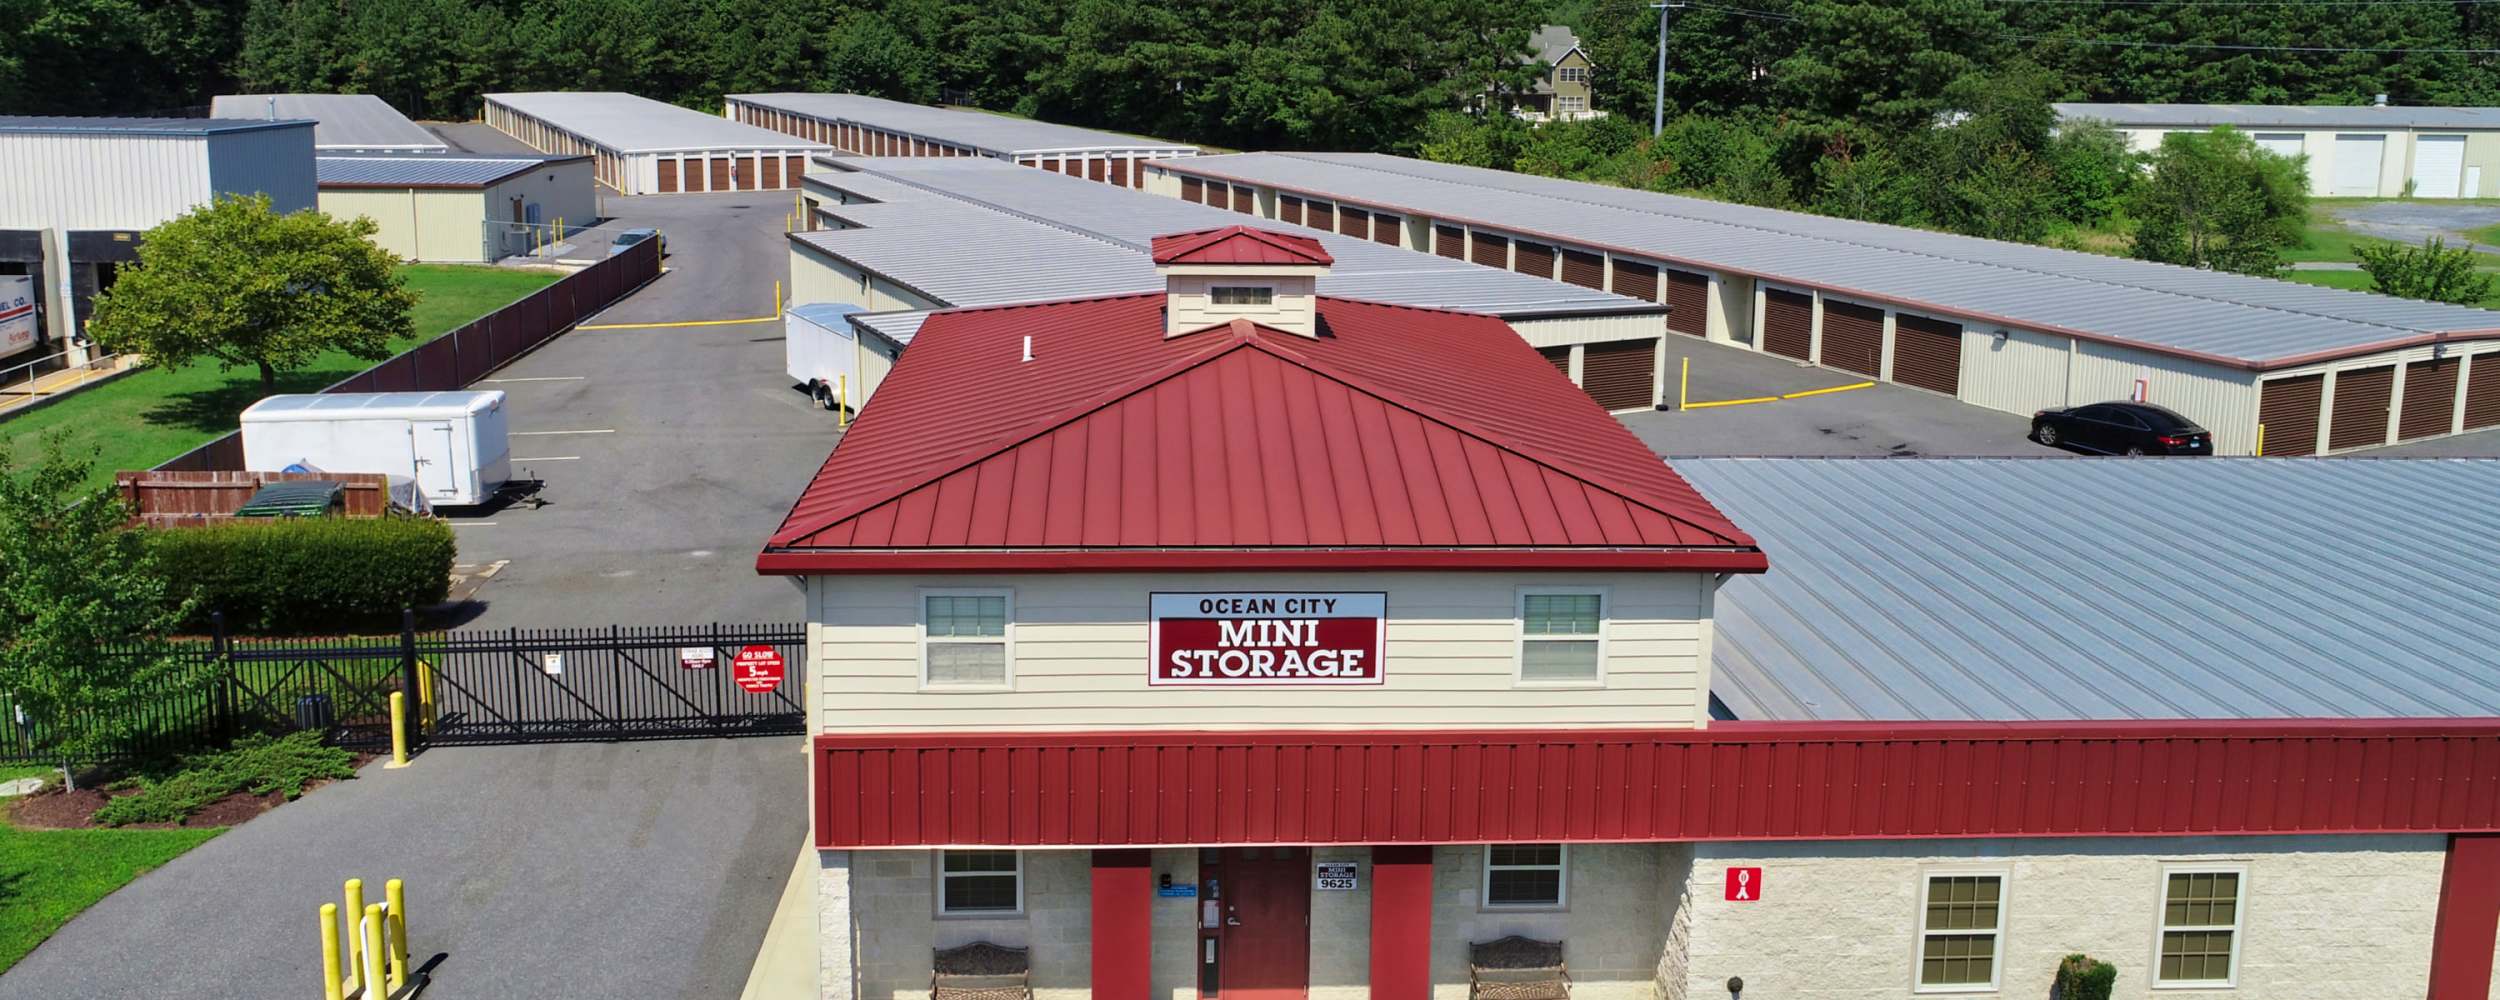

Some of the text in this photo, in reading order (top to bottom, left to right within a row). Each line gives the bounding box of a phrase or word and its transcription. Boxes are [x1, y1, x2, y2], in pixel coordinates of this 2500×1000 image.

[1199, 598, 1337, 614] OCEAN CITY
[1218, 619, 1319, 647] MINI
[742, 651, 774, 660] GO SLOW
[1171, 649, 1364, 677] STORAGE
[749, 666, 757, 677] 5
[1321, 880, 1353, 889] 9625
